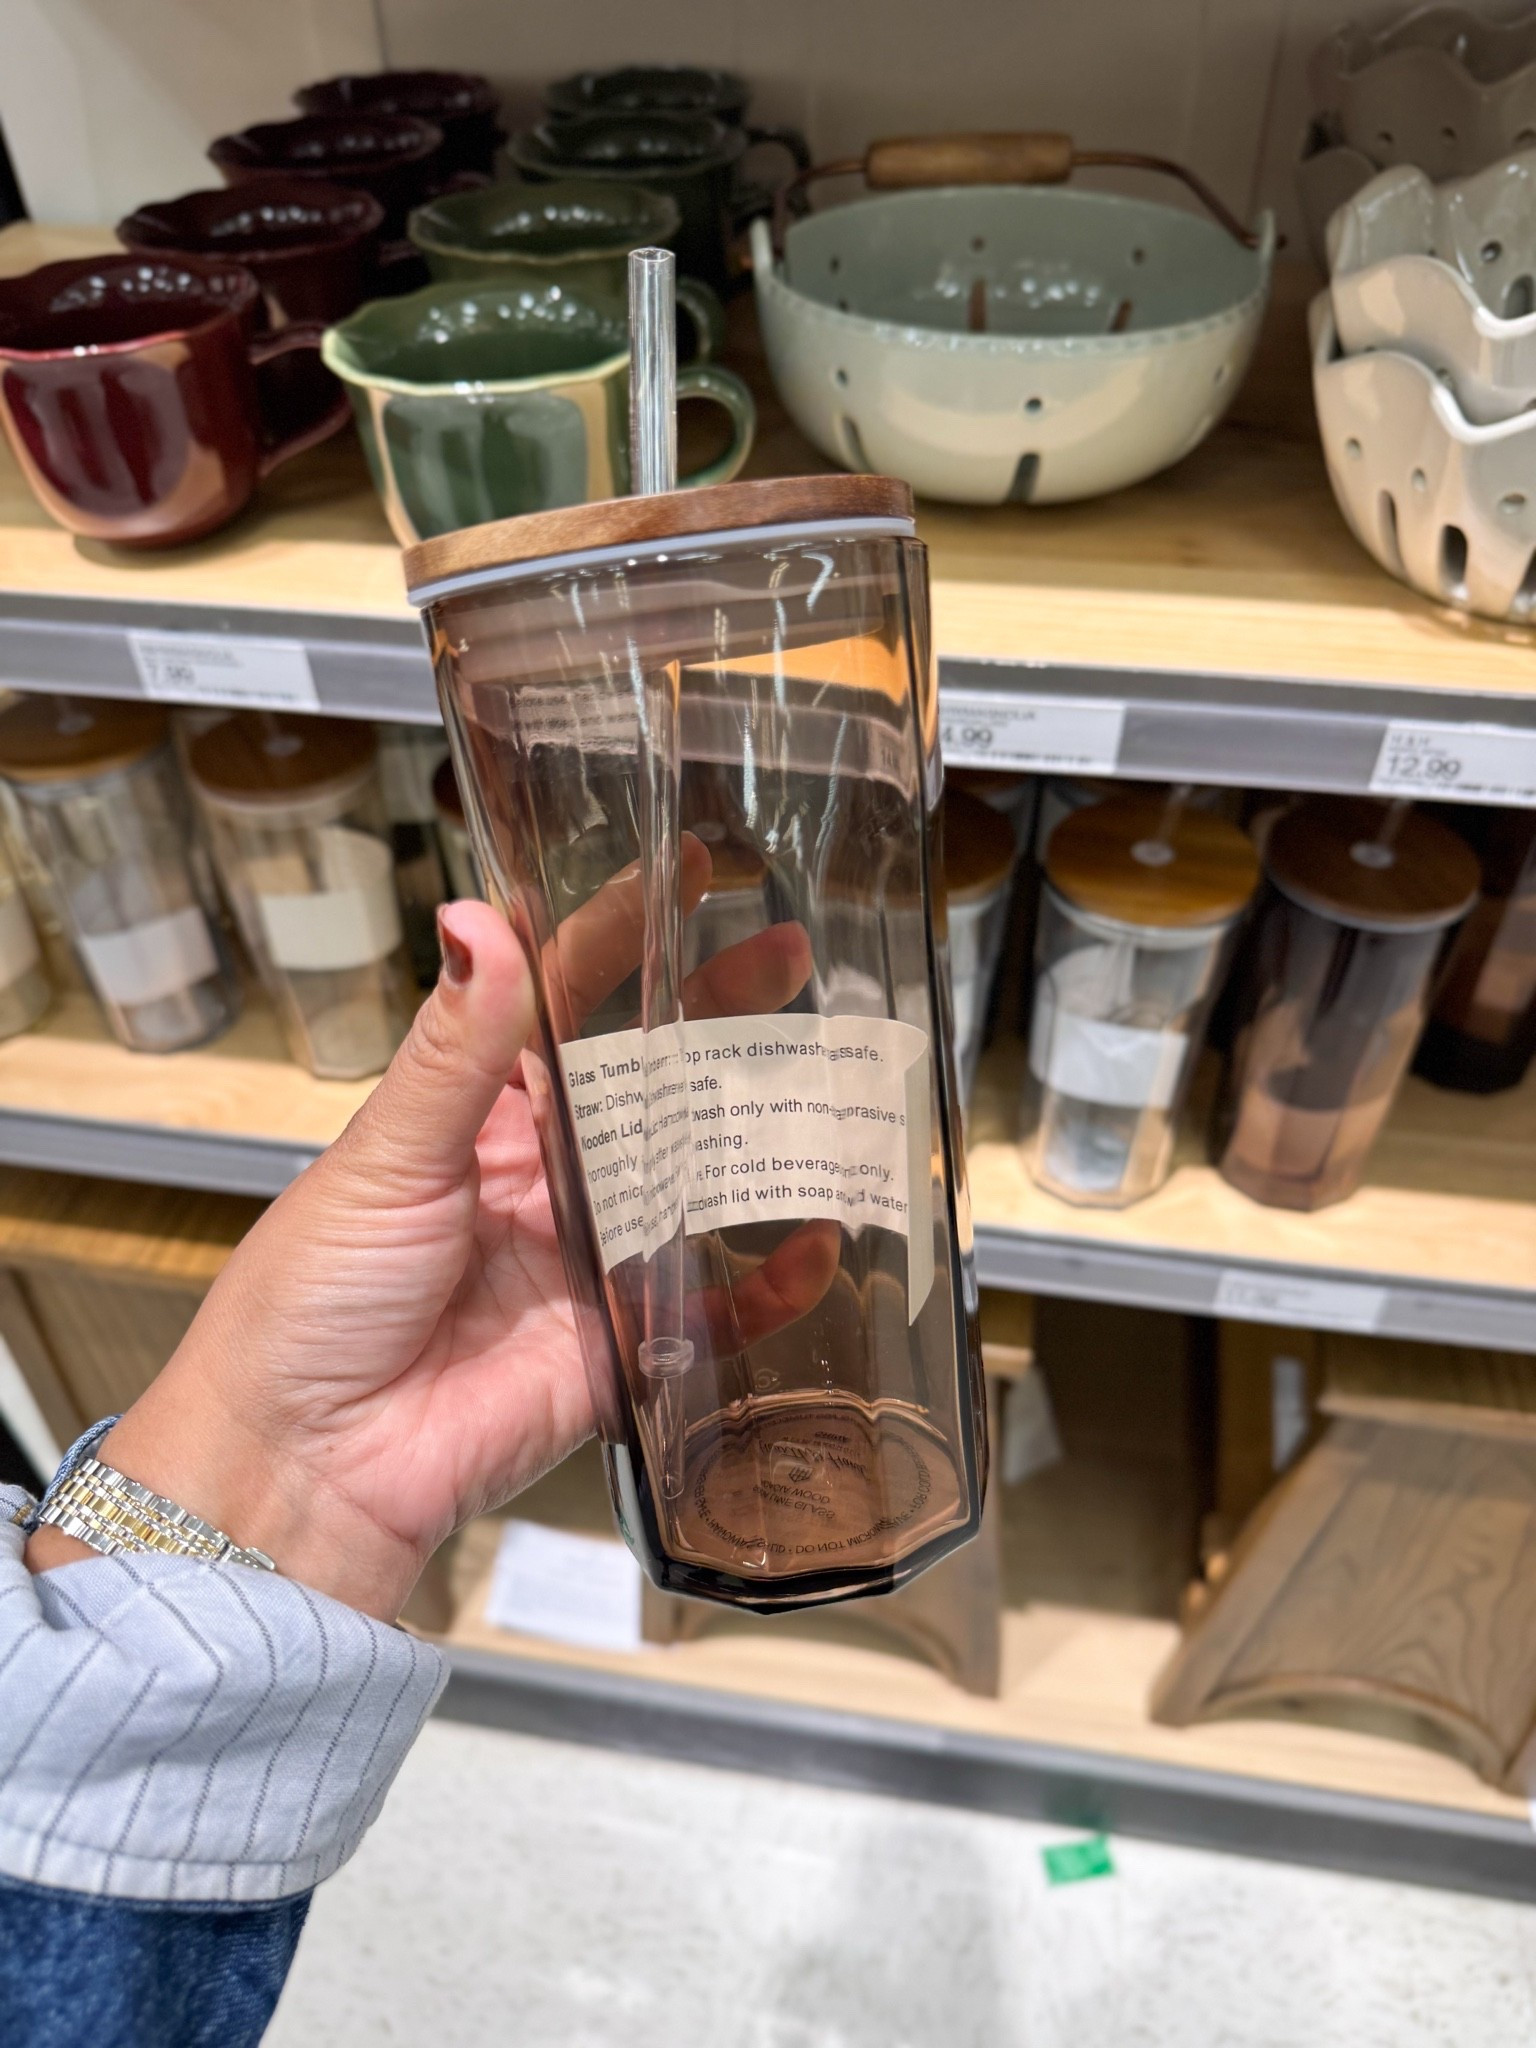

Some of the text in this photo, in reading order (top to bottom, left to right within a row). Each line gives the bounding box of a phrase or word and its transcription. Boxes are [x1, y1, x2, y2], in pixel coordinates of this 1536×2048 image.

[1388, 756, 1462, 781] 12.99
[568, 1069, 597, 1089] Glass
[705, 1043, 742, 1061] rack
[574, 1099, 603, 1121] Straw:
[689, 1075, 722, 1093] safe.
[729, 1100, 765, 1119] only
[769, 1097, 803, 1114] with
[587, 1154, 638, 1184] horoughly
[694, 1132, 749, 1152] ashing.
[602, 1193, 617, 1212] not
[705, 1162, 727, 1179] For
[730, 1157, 766, 1176] cold
[858, 1163, 894, 1182] only.
[731, 1187, 750, 1204] lid
[755, 1184, 793, 1201] with
[797, 1185, 834, 1204] soap
[870, 1192, 908, 1214] water
